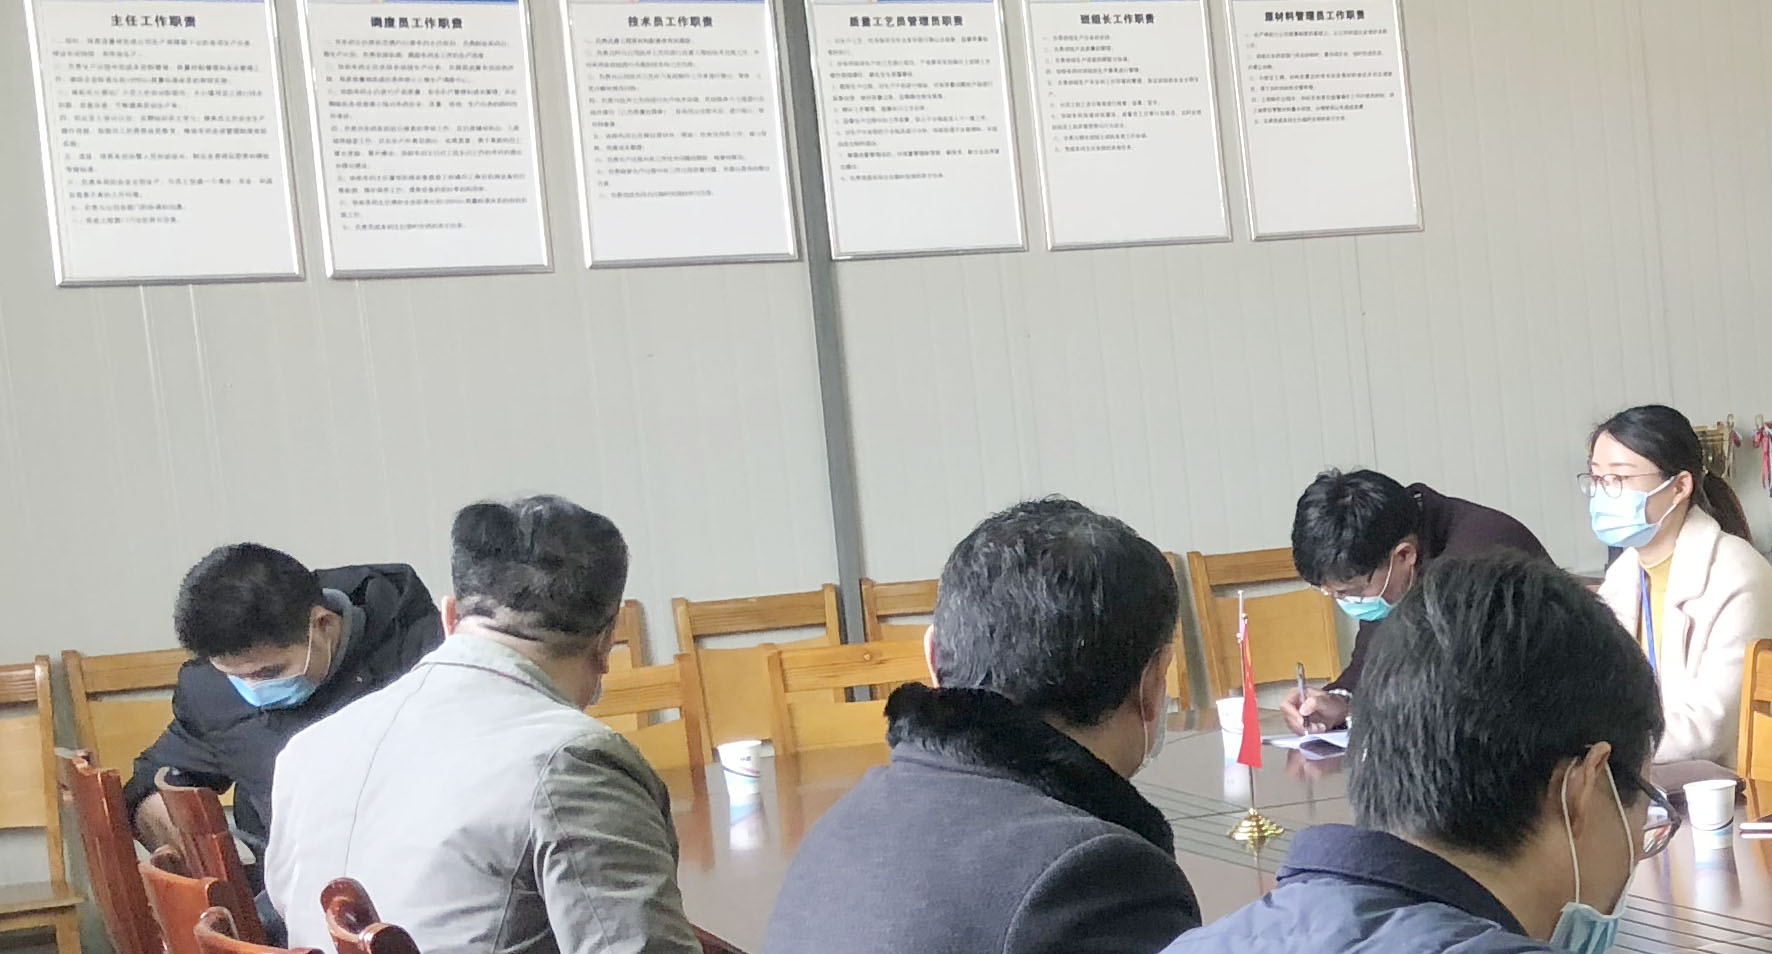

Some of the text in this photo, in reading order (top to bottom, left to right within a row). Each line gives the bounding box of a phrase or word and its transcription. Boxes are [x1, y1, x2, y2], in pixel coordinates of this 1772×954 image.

[110, 14, 197, 28] 主任工作职责
[627, 15, 713, 28] 技术员工作职责
[1080, 13, 1155, 25] 班组长工作职责
[1264, 9, 1366, 22] 原材料管理员工作职责
[370, 16, 463, 30] 调度员工作职责
